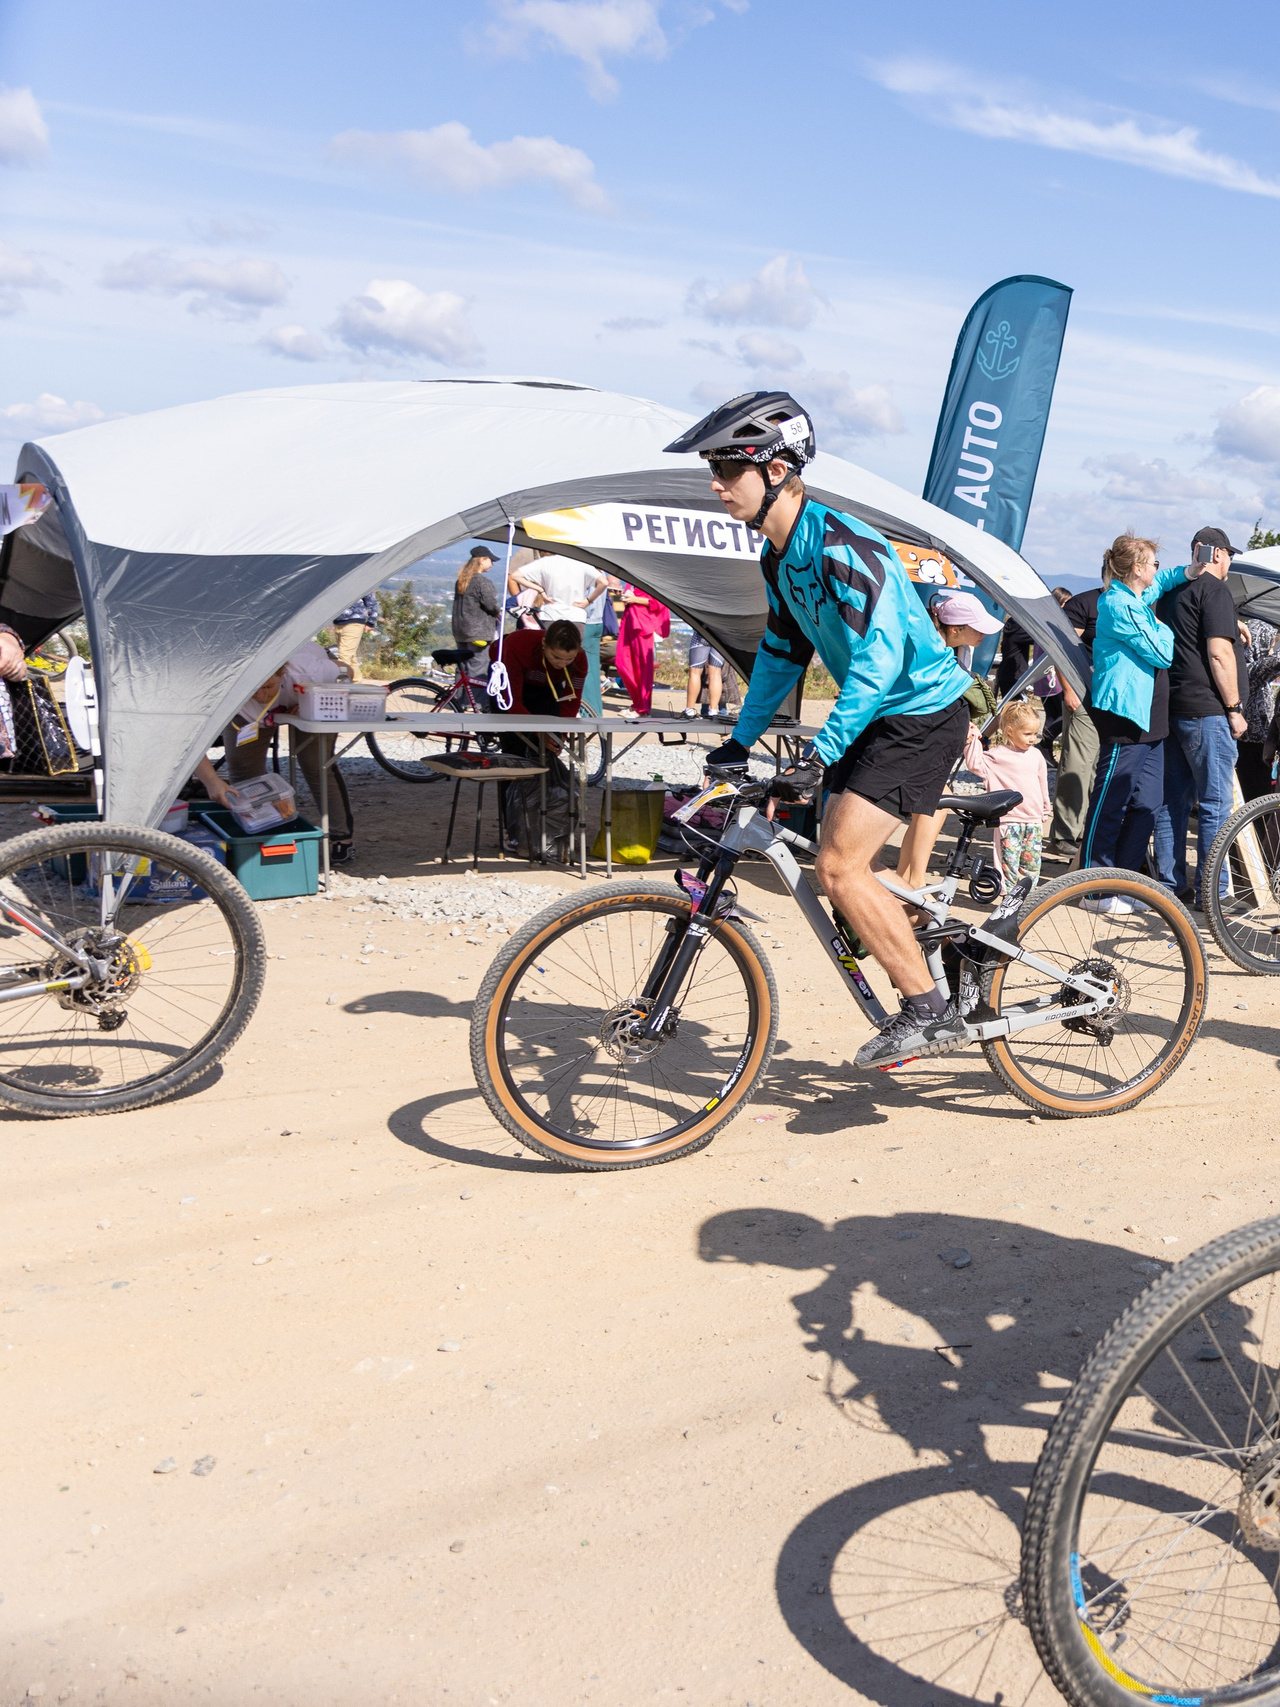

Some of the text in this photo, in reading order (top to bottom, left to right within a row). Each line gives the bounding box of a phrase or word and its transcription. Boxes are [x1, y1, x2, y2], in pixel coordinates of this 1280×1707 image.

[789, 421, 804, 436] 58
[953, 400, 1003, 510] AUTO
[148, 878, 189, 891] Sultana
[591, 896, 630, 911] JACK
[633, 896, 691, 910] RABBIT
[1159, 982, 1204, 1078] CST JACK RABBIT
